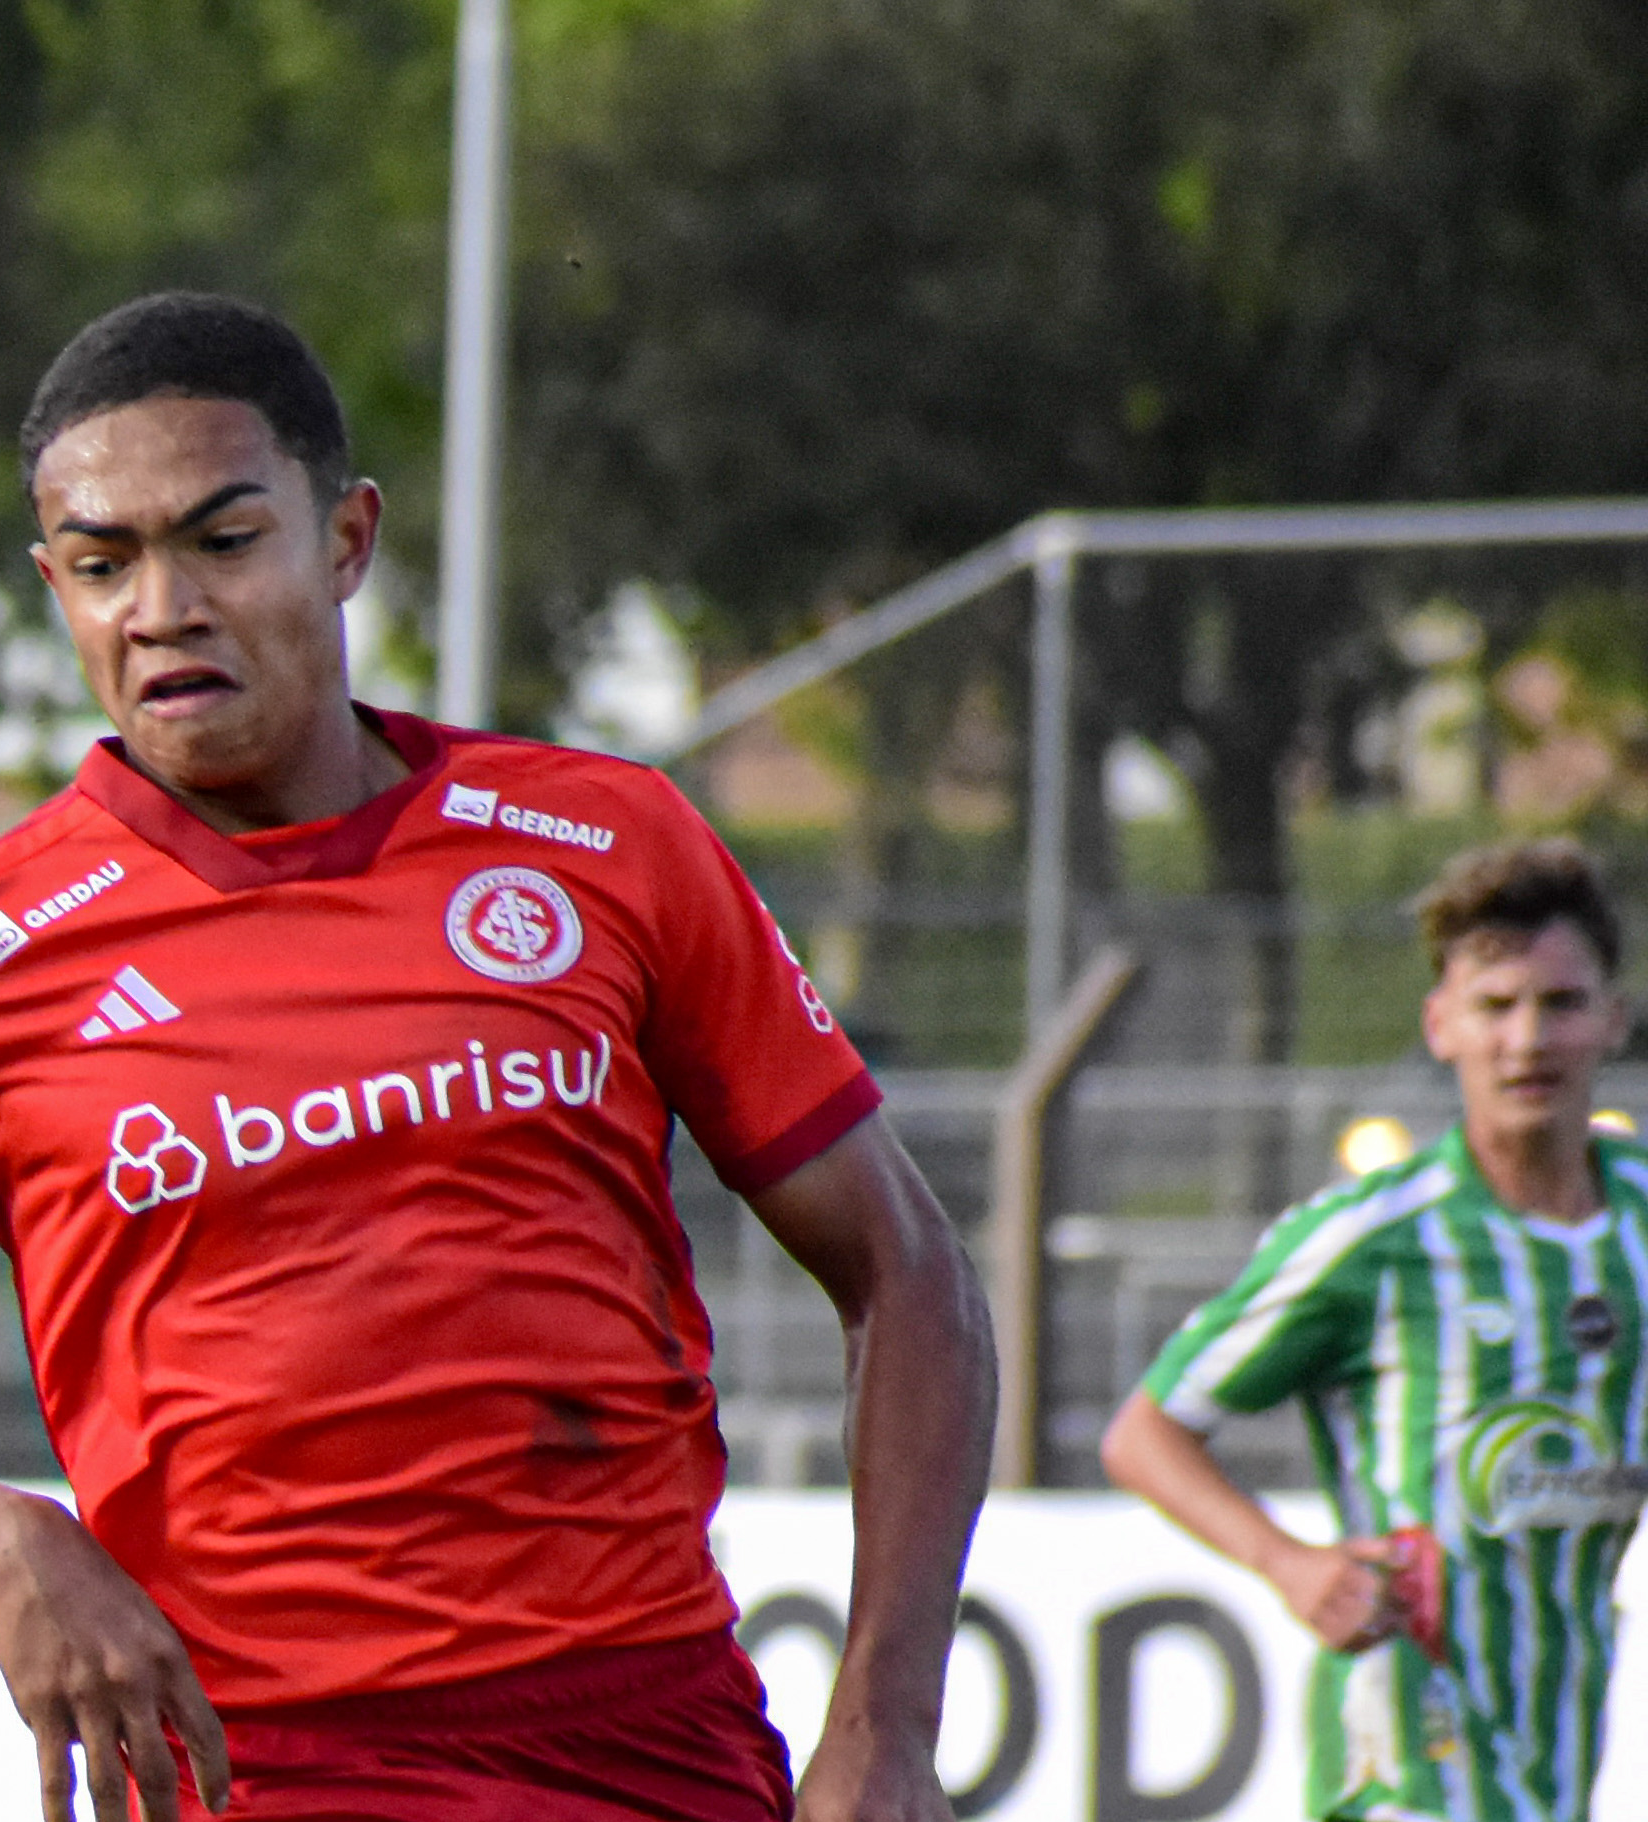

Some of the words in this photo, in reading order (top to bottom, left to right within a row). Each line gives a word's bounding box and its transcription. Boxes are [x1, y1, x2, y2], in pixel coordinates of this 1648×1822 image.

[498, 804, 616, 853] GERDAU
[22, 859, 126, 929] GERDAU
[214, 1030, 610, 1169] banrisul
